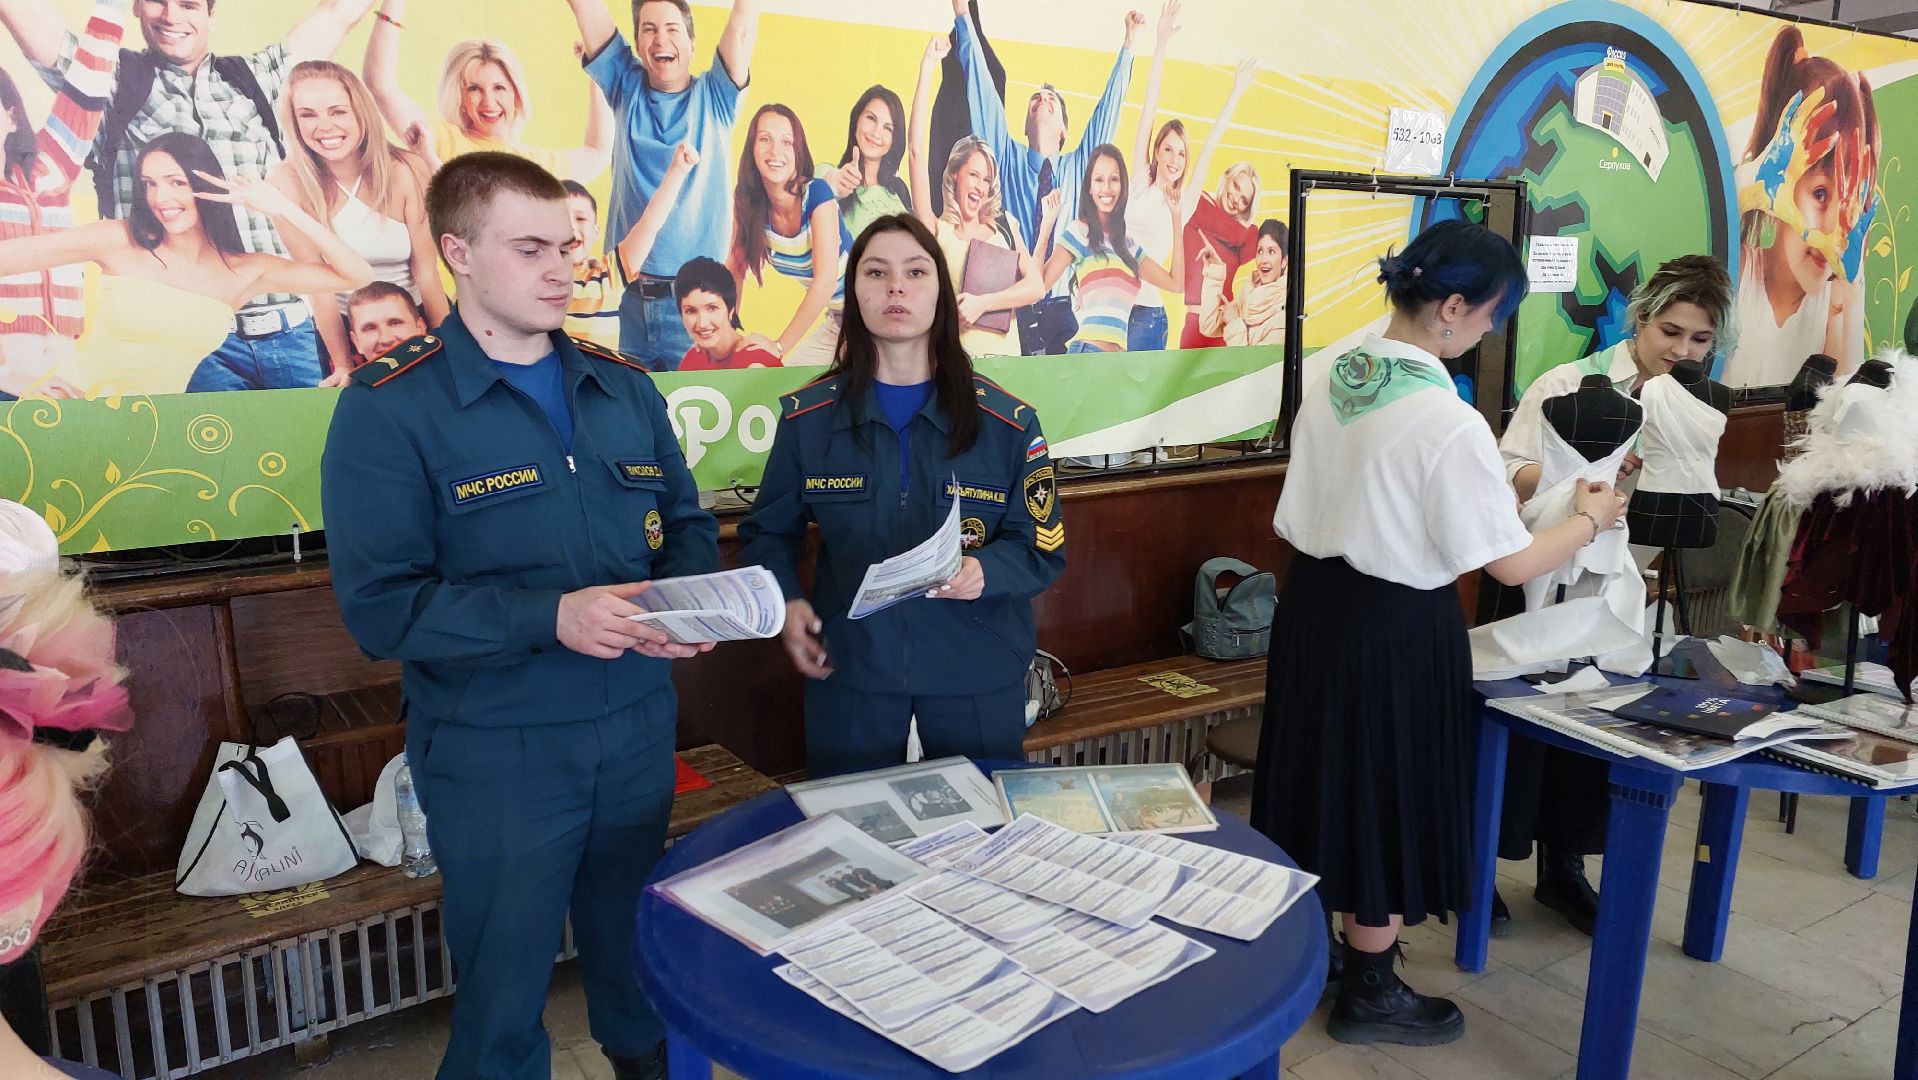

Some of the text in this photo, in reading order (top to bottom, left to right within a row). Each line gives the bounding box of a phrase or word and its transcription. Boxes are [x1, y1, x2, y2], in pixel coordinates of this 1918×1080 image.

[1393, 127, 1411, 142] 532
[1599, 159, 1631, 171] Серпухов
[455, 468, 539, 500] МЧС РОССИИ
[805, 476, 865, 490] МЧС РОССИИ
